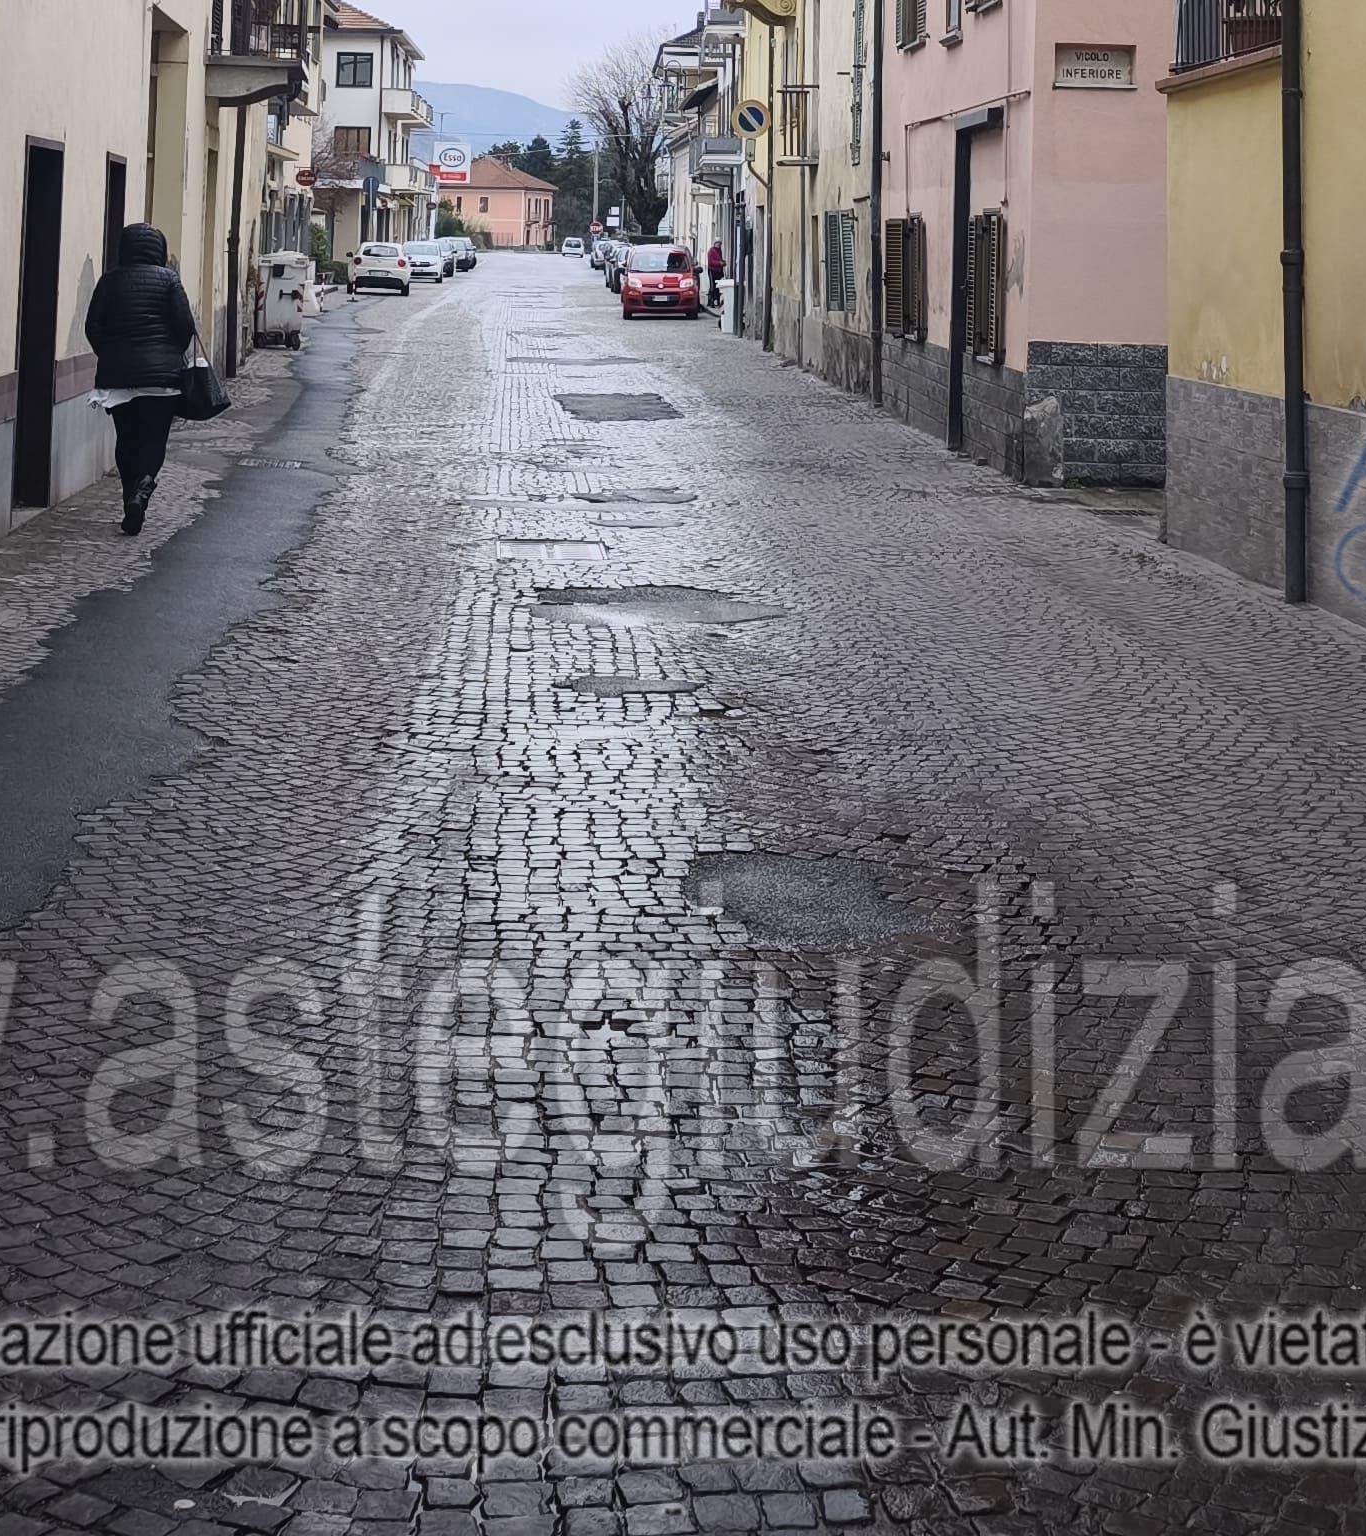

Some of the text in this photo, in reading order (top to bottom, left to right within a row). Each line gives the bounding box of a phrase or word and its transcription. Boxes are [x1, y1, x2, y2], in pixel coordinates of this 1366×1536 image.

[1075, 52, 1109, 62] VICOLO
[1062, 68, 1122, 79] INFERIORE
[443, 153, 462, 162] Esso
